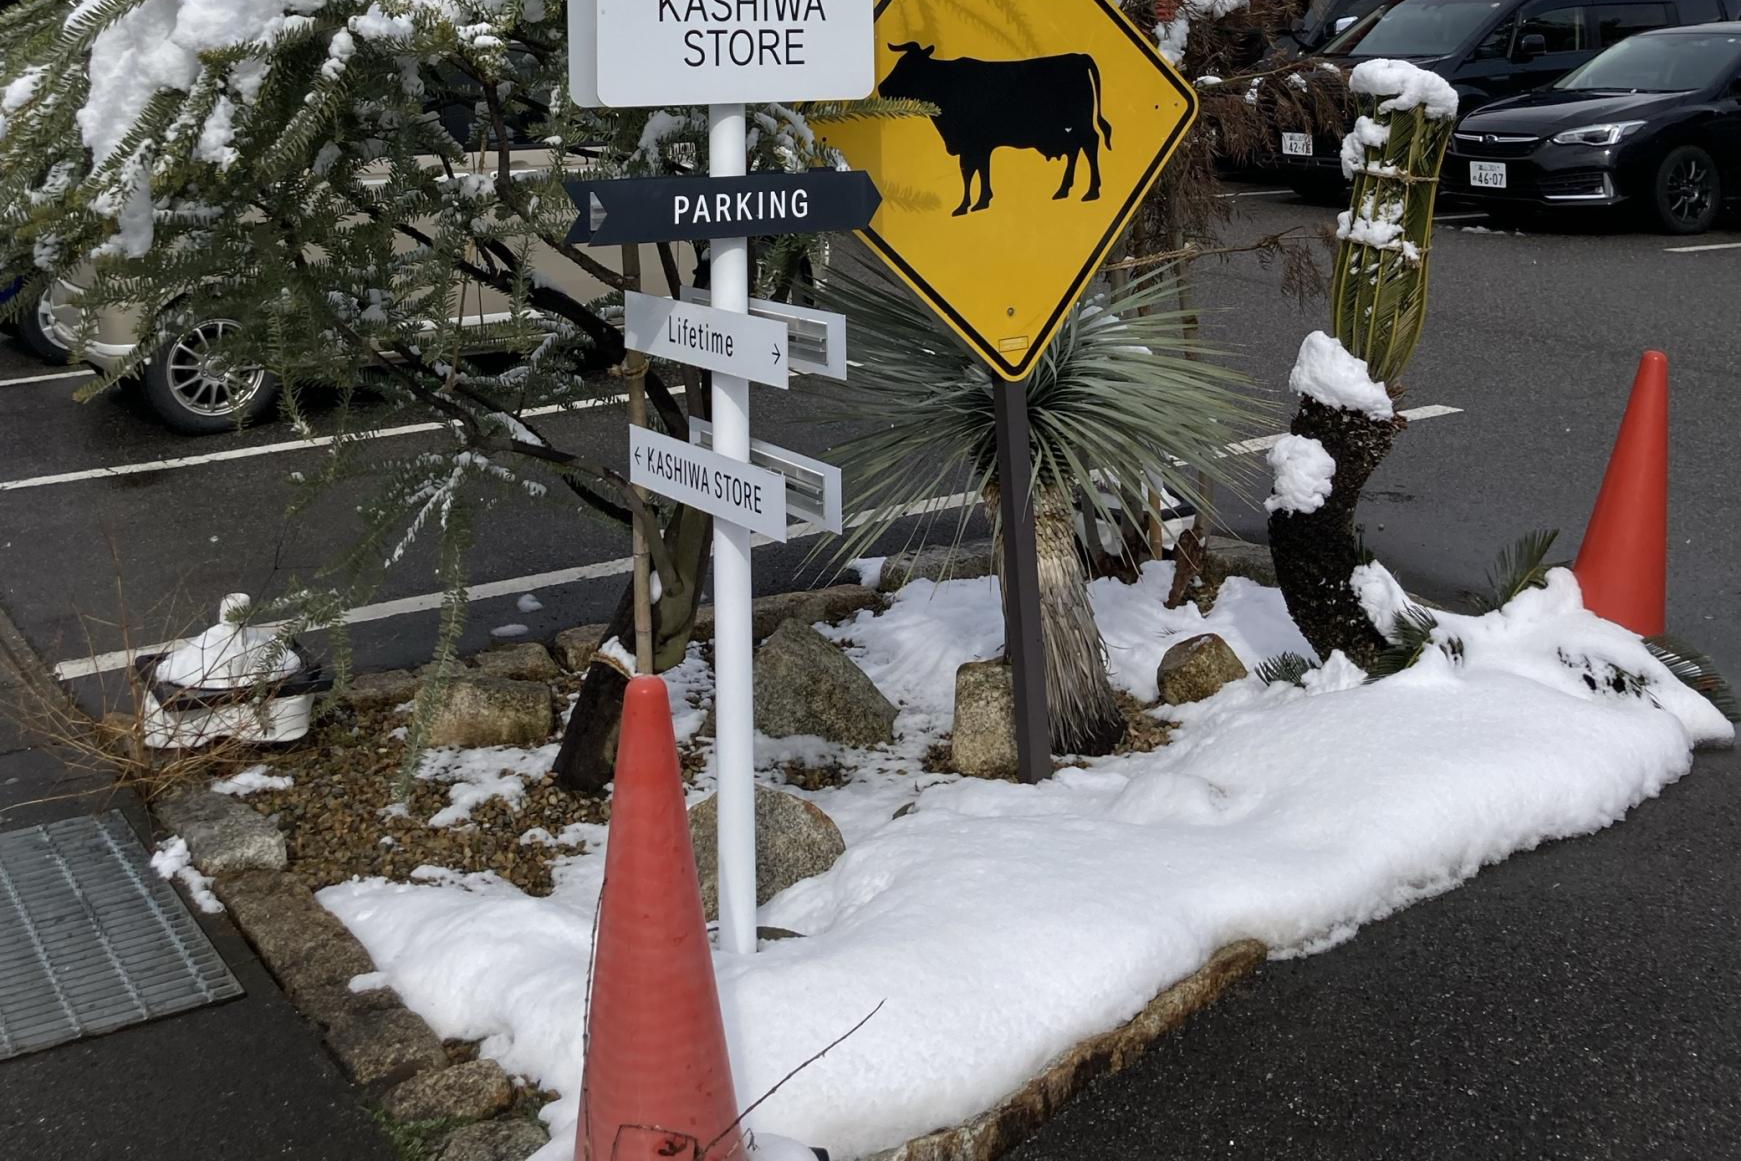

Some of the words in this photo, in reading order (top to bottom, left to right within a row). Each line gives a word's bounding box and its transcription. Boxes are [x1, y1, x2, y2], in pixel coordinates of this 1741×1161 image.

[684, 28, 805, 67] STORE
[674, 188, 809, 225] PARKING
[668, 314, 734, 357] Lifetime
[647, 446, 711, 495] KASHIWA
[714, 473, 763, 515] STORE
